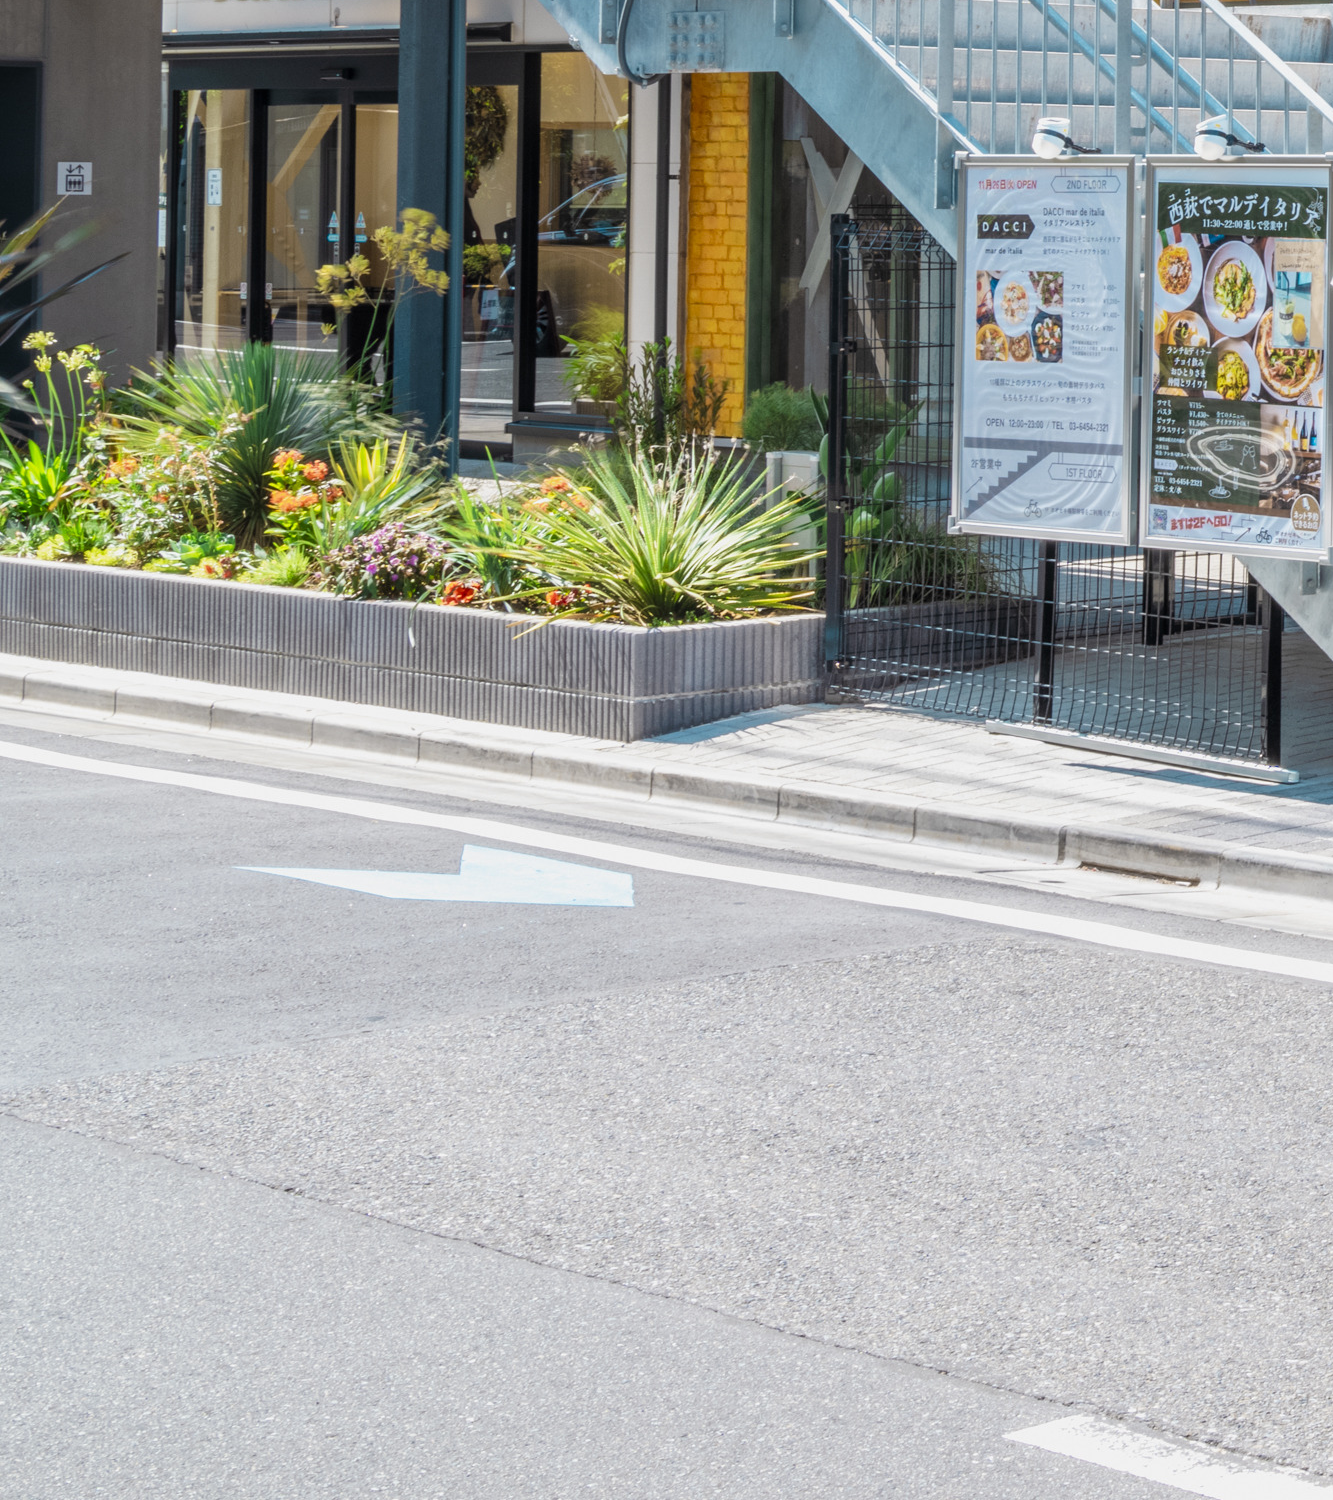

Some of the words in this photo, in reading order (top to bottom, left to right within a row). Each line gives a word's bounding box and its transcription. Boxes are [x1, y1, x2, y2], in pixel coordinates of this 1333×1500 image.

[1016, 180, 1038, 190] OPEN
[1066, 180, 1082, 190] 2ND
[1083, 180, 1107, 190] FLOOR
[1080, 208, 1088, 216] de
[982, 222, 1026, 232] DACCI
[998, 247, 1006, 255] de
[1171, 368, 1206, 378] おひとりさま
[985, 418, 1005, 427] OPEN
[1052, 421, 1064, 430] TEL
[970, 458, 1002, 470] 2F営業中
[1066, 468, 1077, 478] 1ST
[1078, 468, 1103, 479] FLOOR
[1293, 510, 1319, 521] ネット予約
[1293, 519, 1319, 530] できるお店
